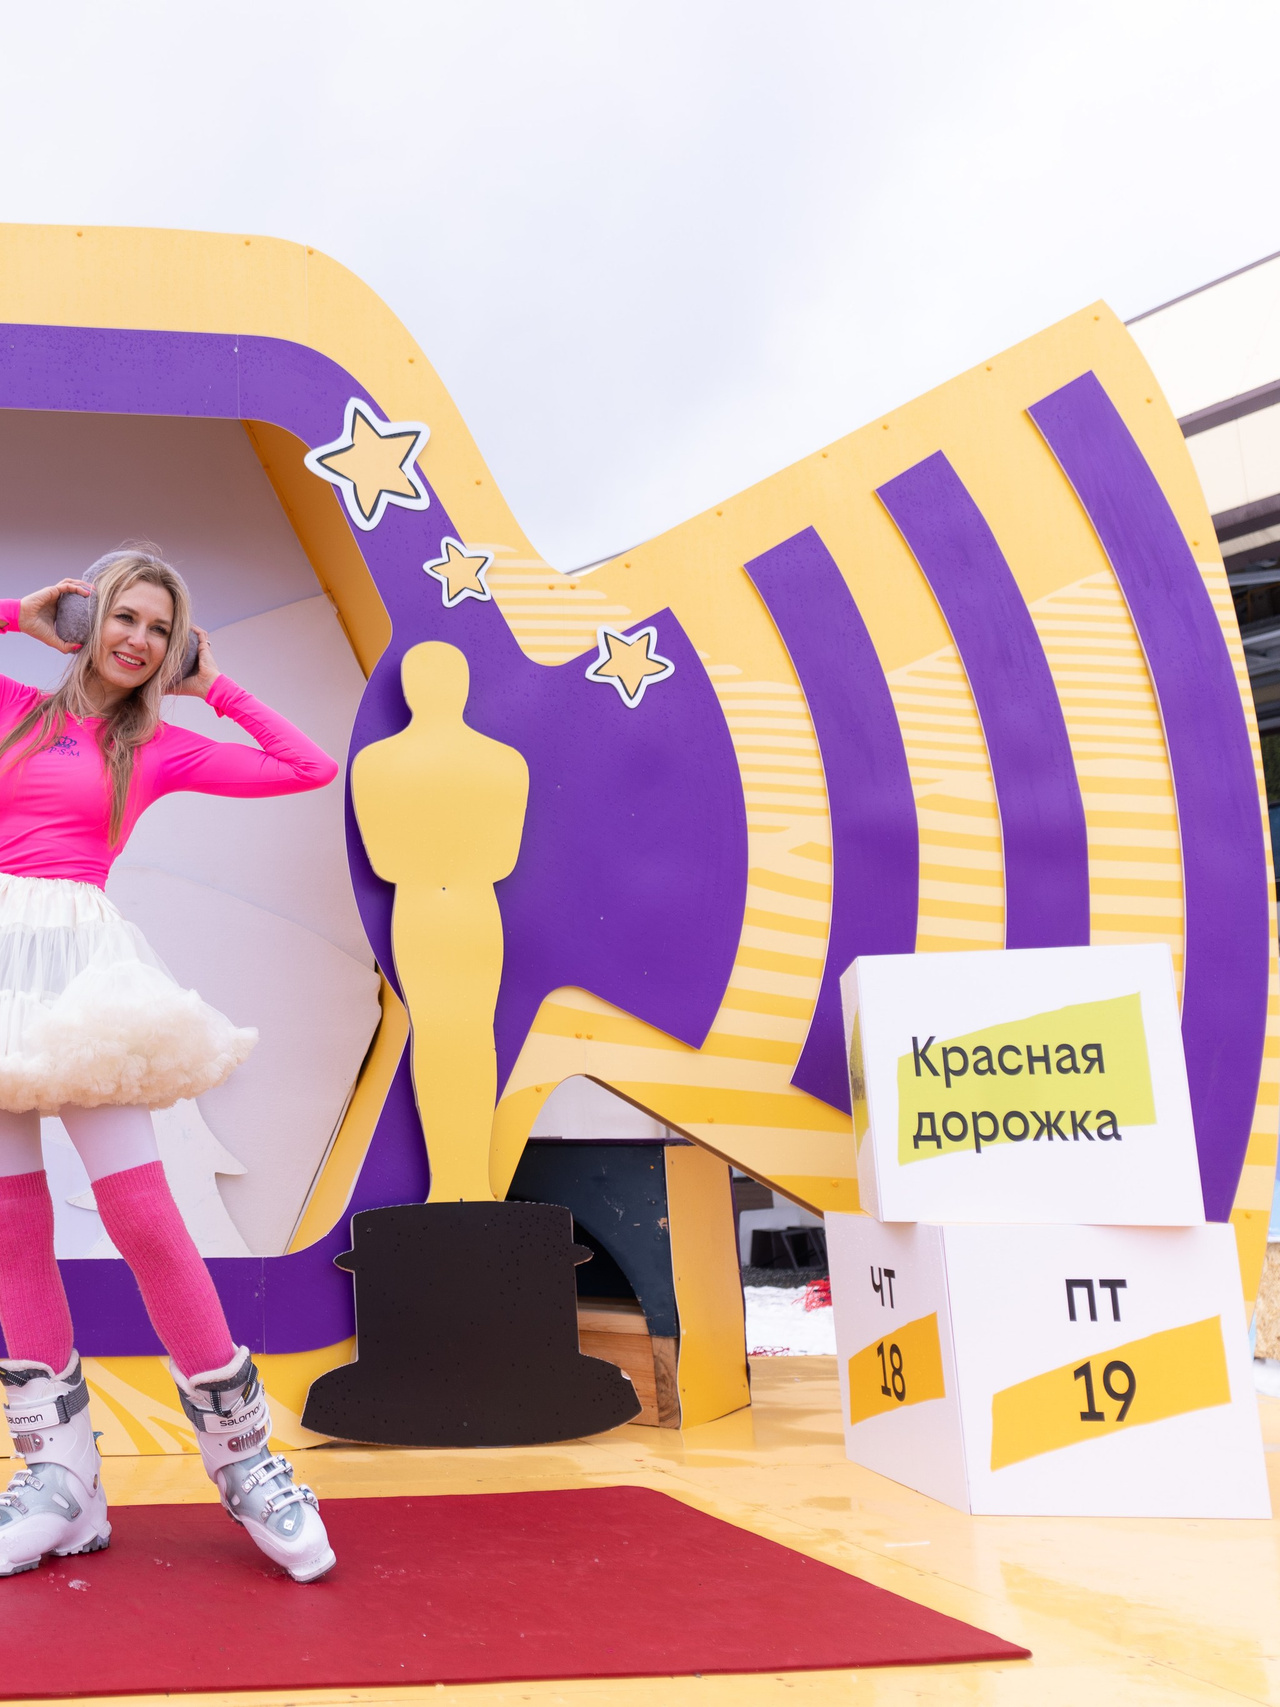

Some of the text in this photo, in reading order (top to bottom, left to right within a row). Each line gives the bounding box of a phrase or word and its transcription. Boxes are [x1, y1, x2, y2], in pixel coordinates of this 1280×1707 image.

[911, 1034, 1106, 1088] Красная
[912, 1107, 1122, 1153] дорожка
[876, 1340, 906, 1402] 18
[1072, 1359, 1138, 1423] 19
